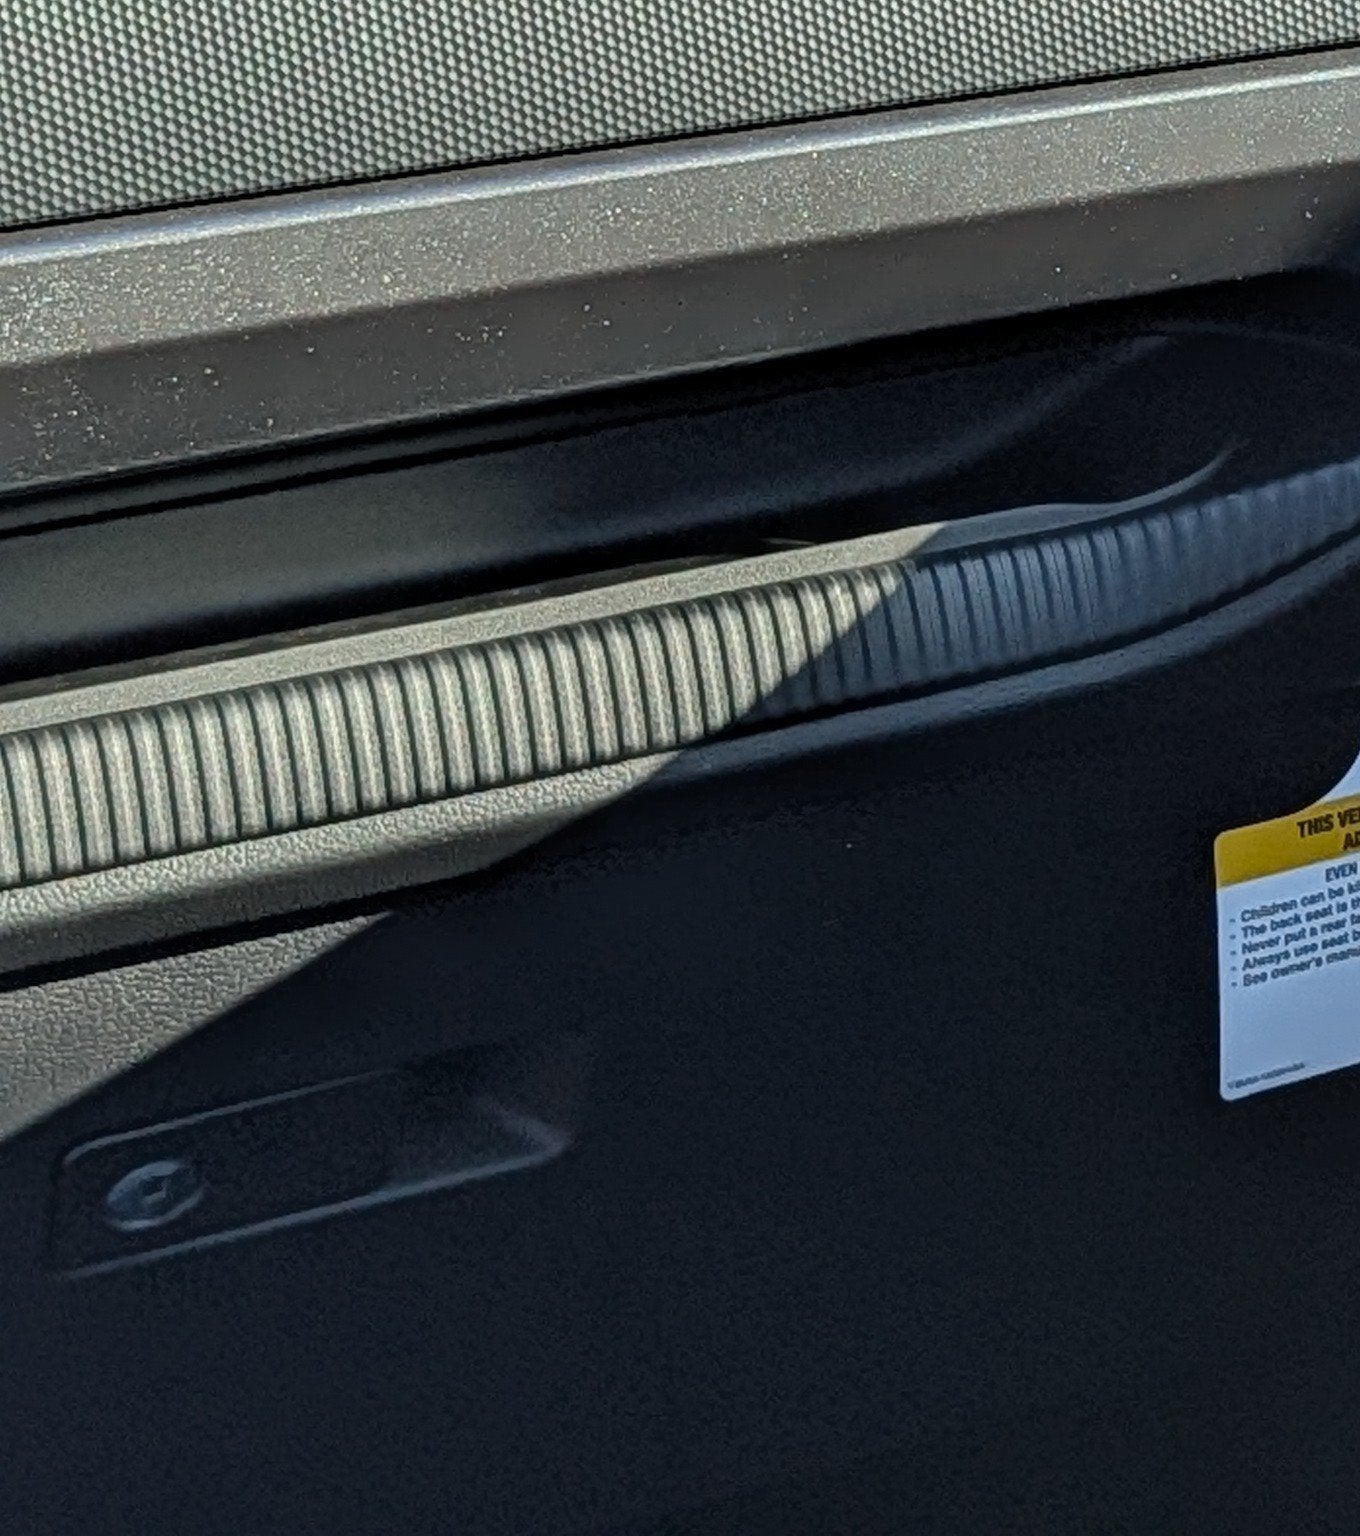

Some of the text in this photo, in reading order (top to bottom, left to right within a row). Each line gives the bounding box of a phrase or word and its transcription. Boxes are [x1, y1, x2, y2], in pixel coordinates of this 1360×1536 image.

[1296, 813, 1334, 838] THIS
[1325, 861, 1357, 882] EVEN
[1240, 899, 1298, 922] Children
[1300, 891, 1325, 906] can
[1327, 886, 1344, 899] be
[1240, 923, 1267, 938] The
[1269, 912, 1302, 931] back
[1304, 903, 1333, 922] seat
[1336, 901, 1348, 913] is
[1241, 935, 1281, 955] Never
[1284, 926, 1306, 946] put
[1320, 918, 1346, 933] rear
[1241, 949, 1291, 971] Always
[1293, 942, 1318, 957] use
[1321, 931, 1349, 949] seat
[1242, 971, 1268, 987] See
[1270, 956, 1323, 979] owner's
